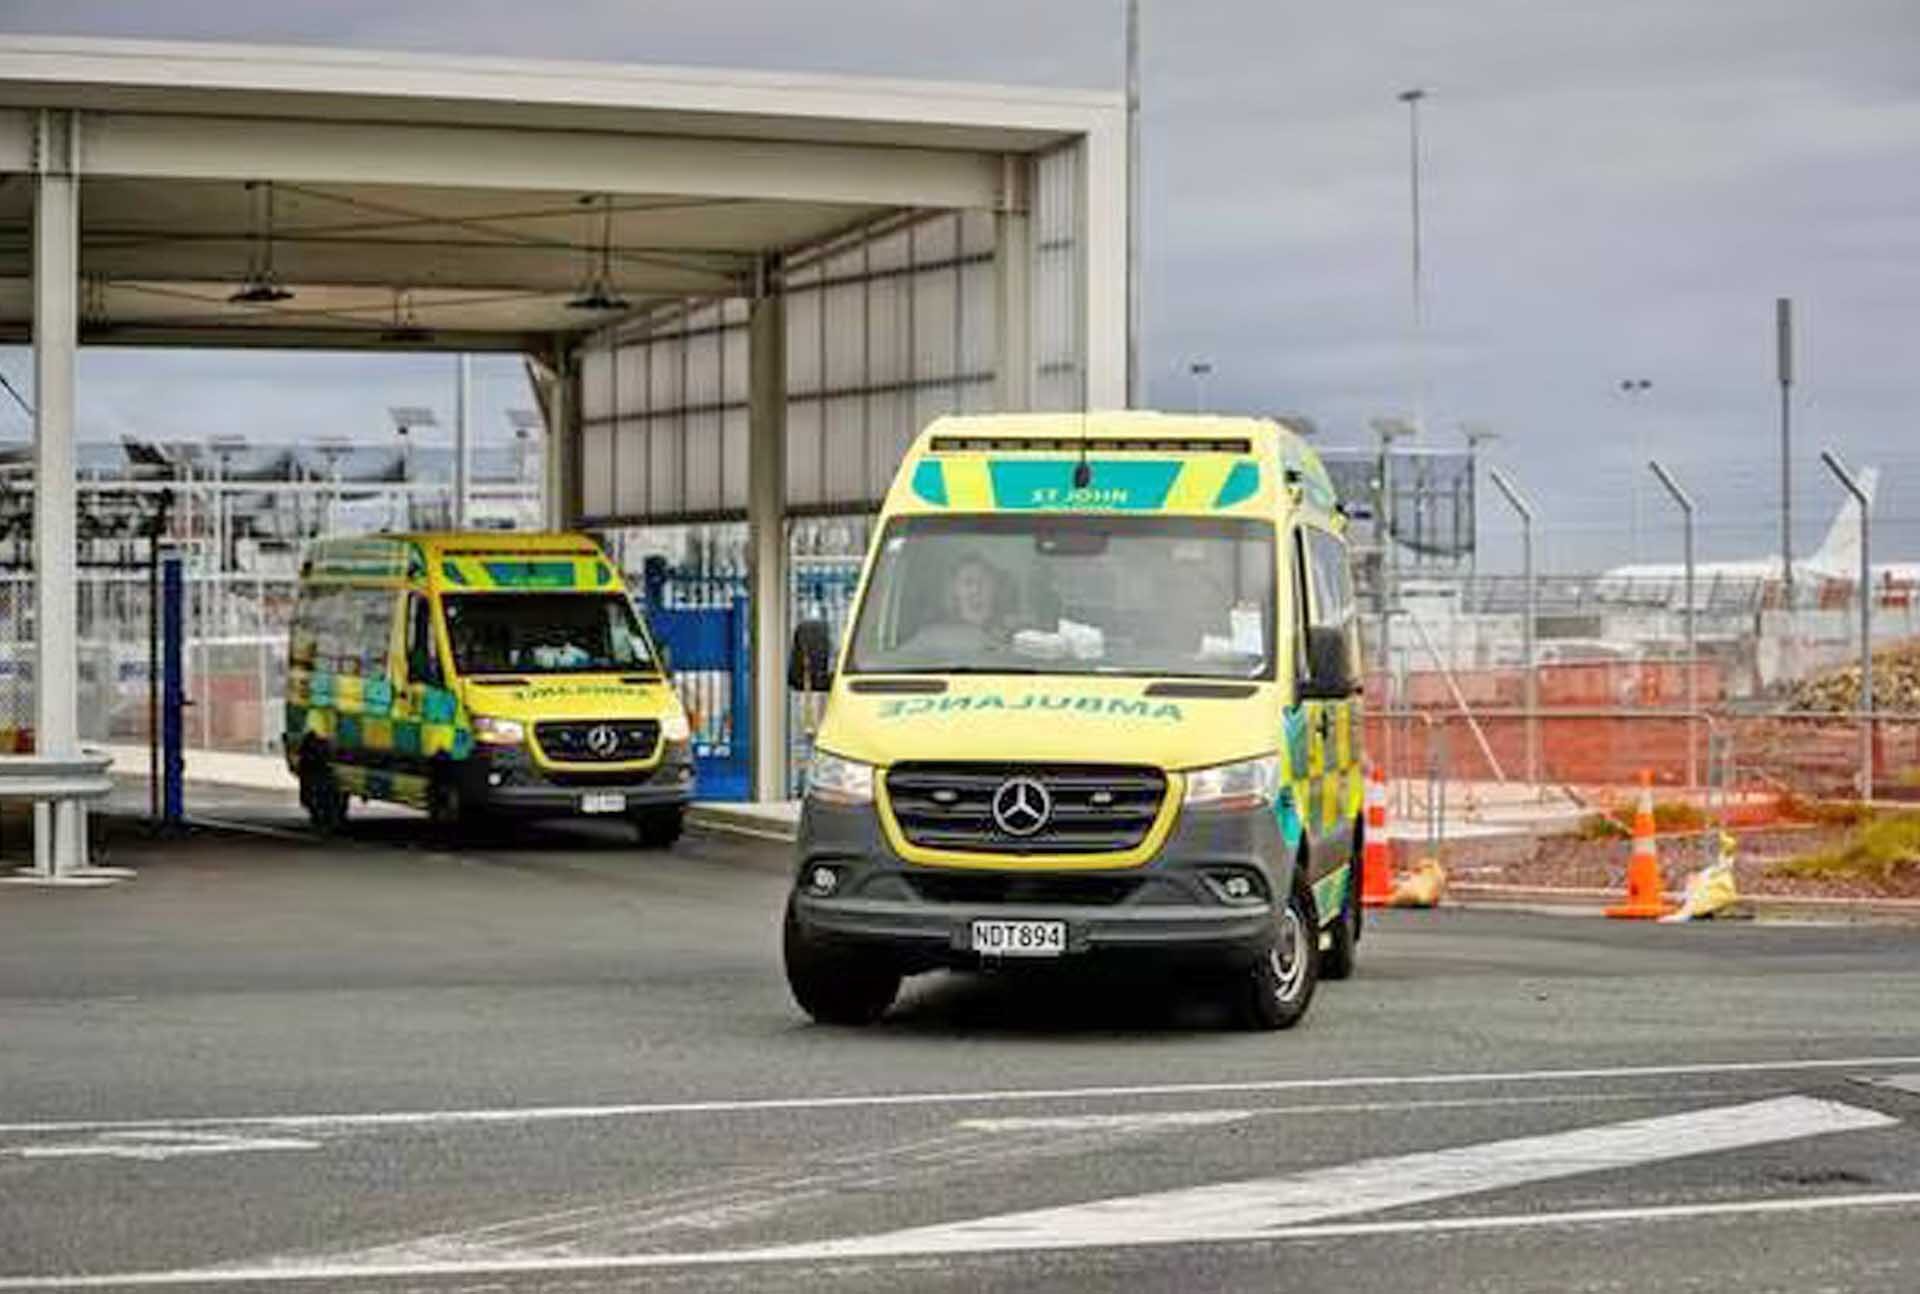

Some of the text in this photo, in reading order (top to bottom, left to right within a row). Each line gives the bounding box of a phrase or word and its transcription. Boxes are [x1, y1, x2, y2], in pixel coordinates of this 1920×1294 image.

[1032, 488, 1129, 502] ST JOHN
[975, 924, 1060, 947] NDT894
